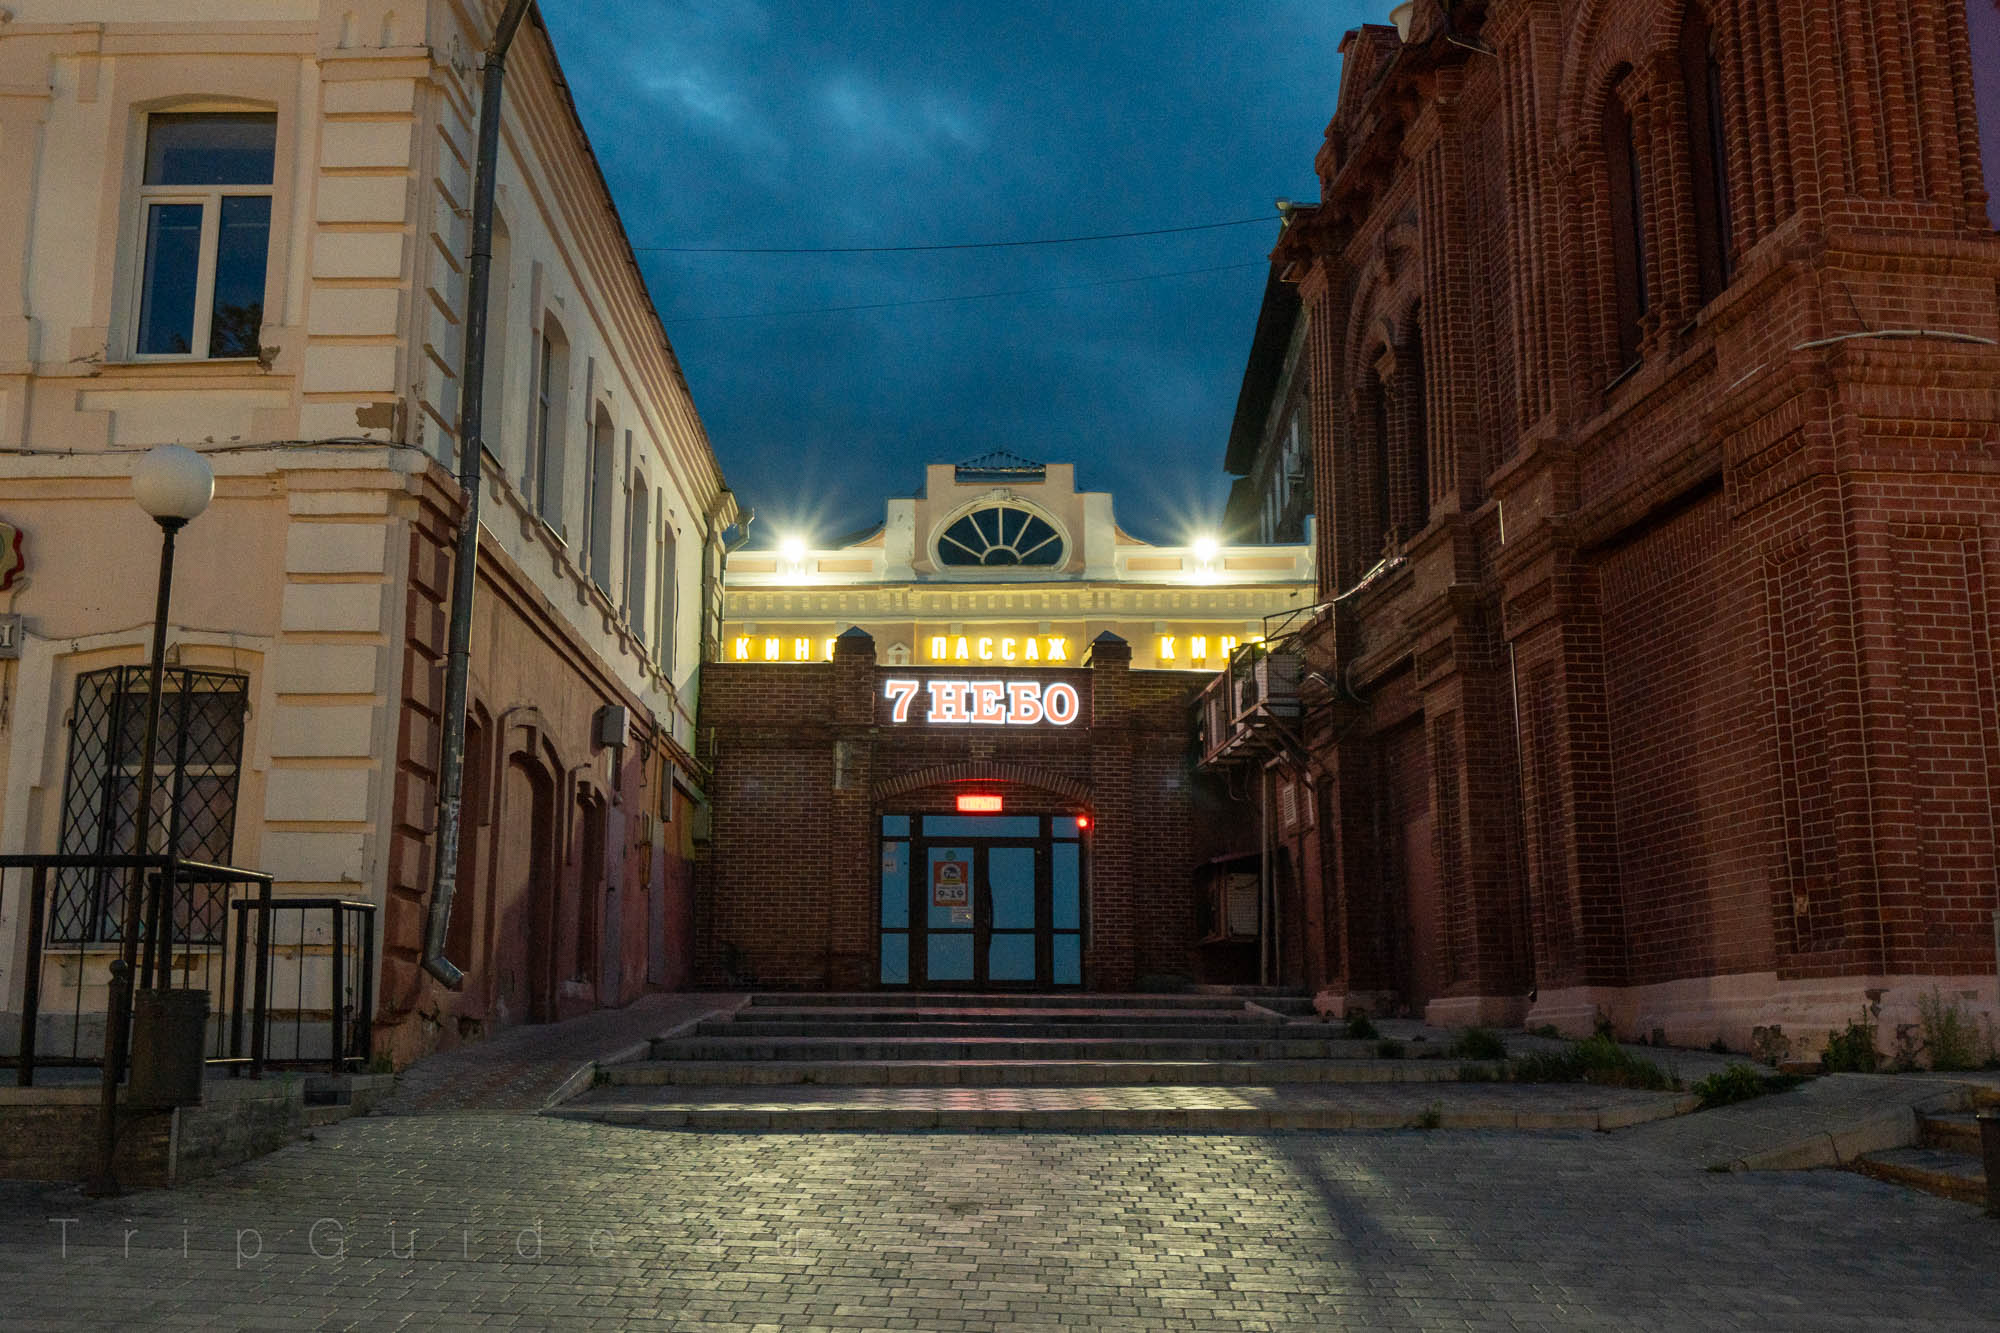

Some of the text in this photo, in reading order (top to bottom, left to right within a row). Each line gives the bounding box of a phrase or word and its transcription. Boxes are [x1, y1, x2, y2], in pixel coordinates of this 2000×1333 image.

[931, 636, 1067, 660] ПАССАЖ
[885, 680, 1079, 725] 7 НЕБО
